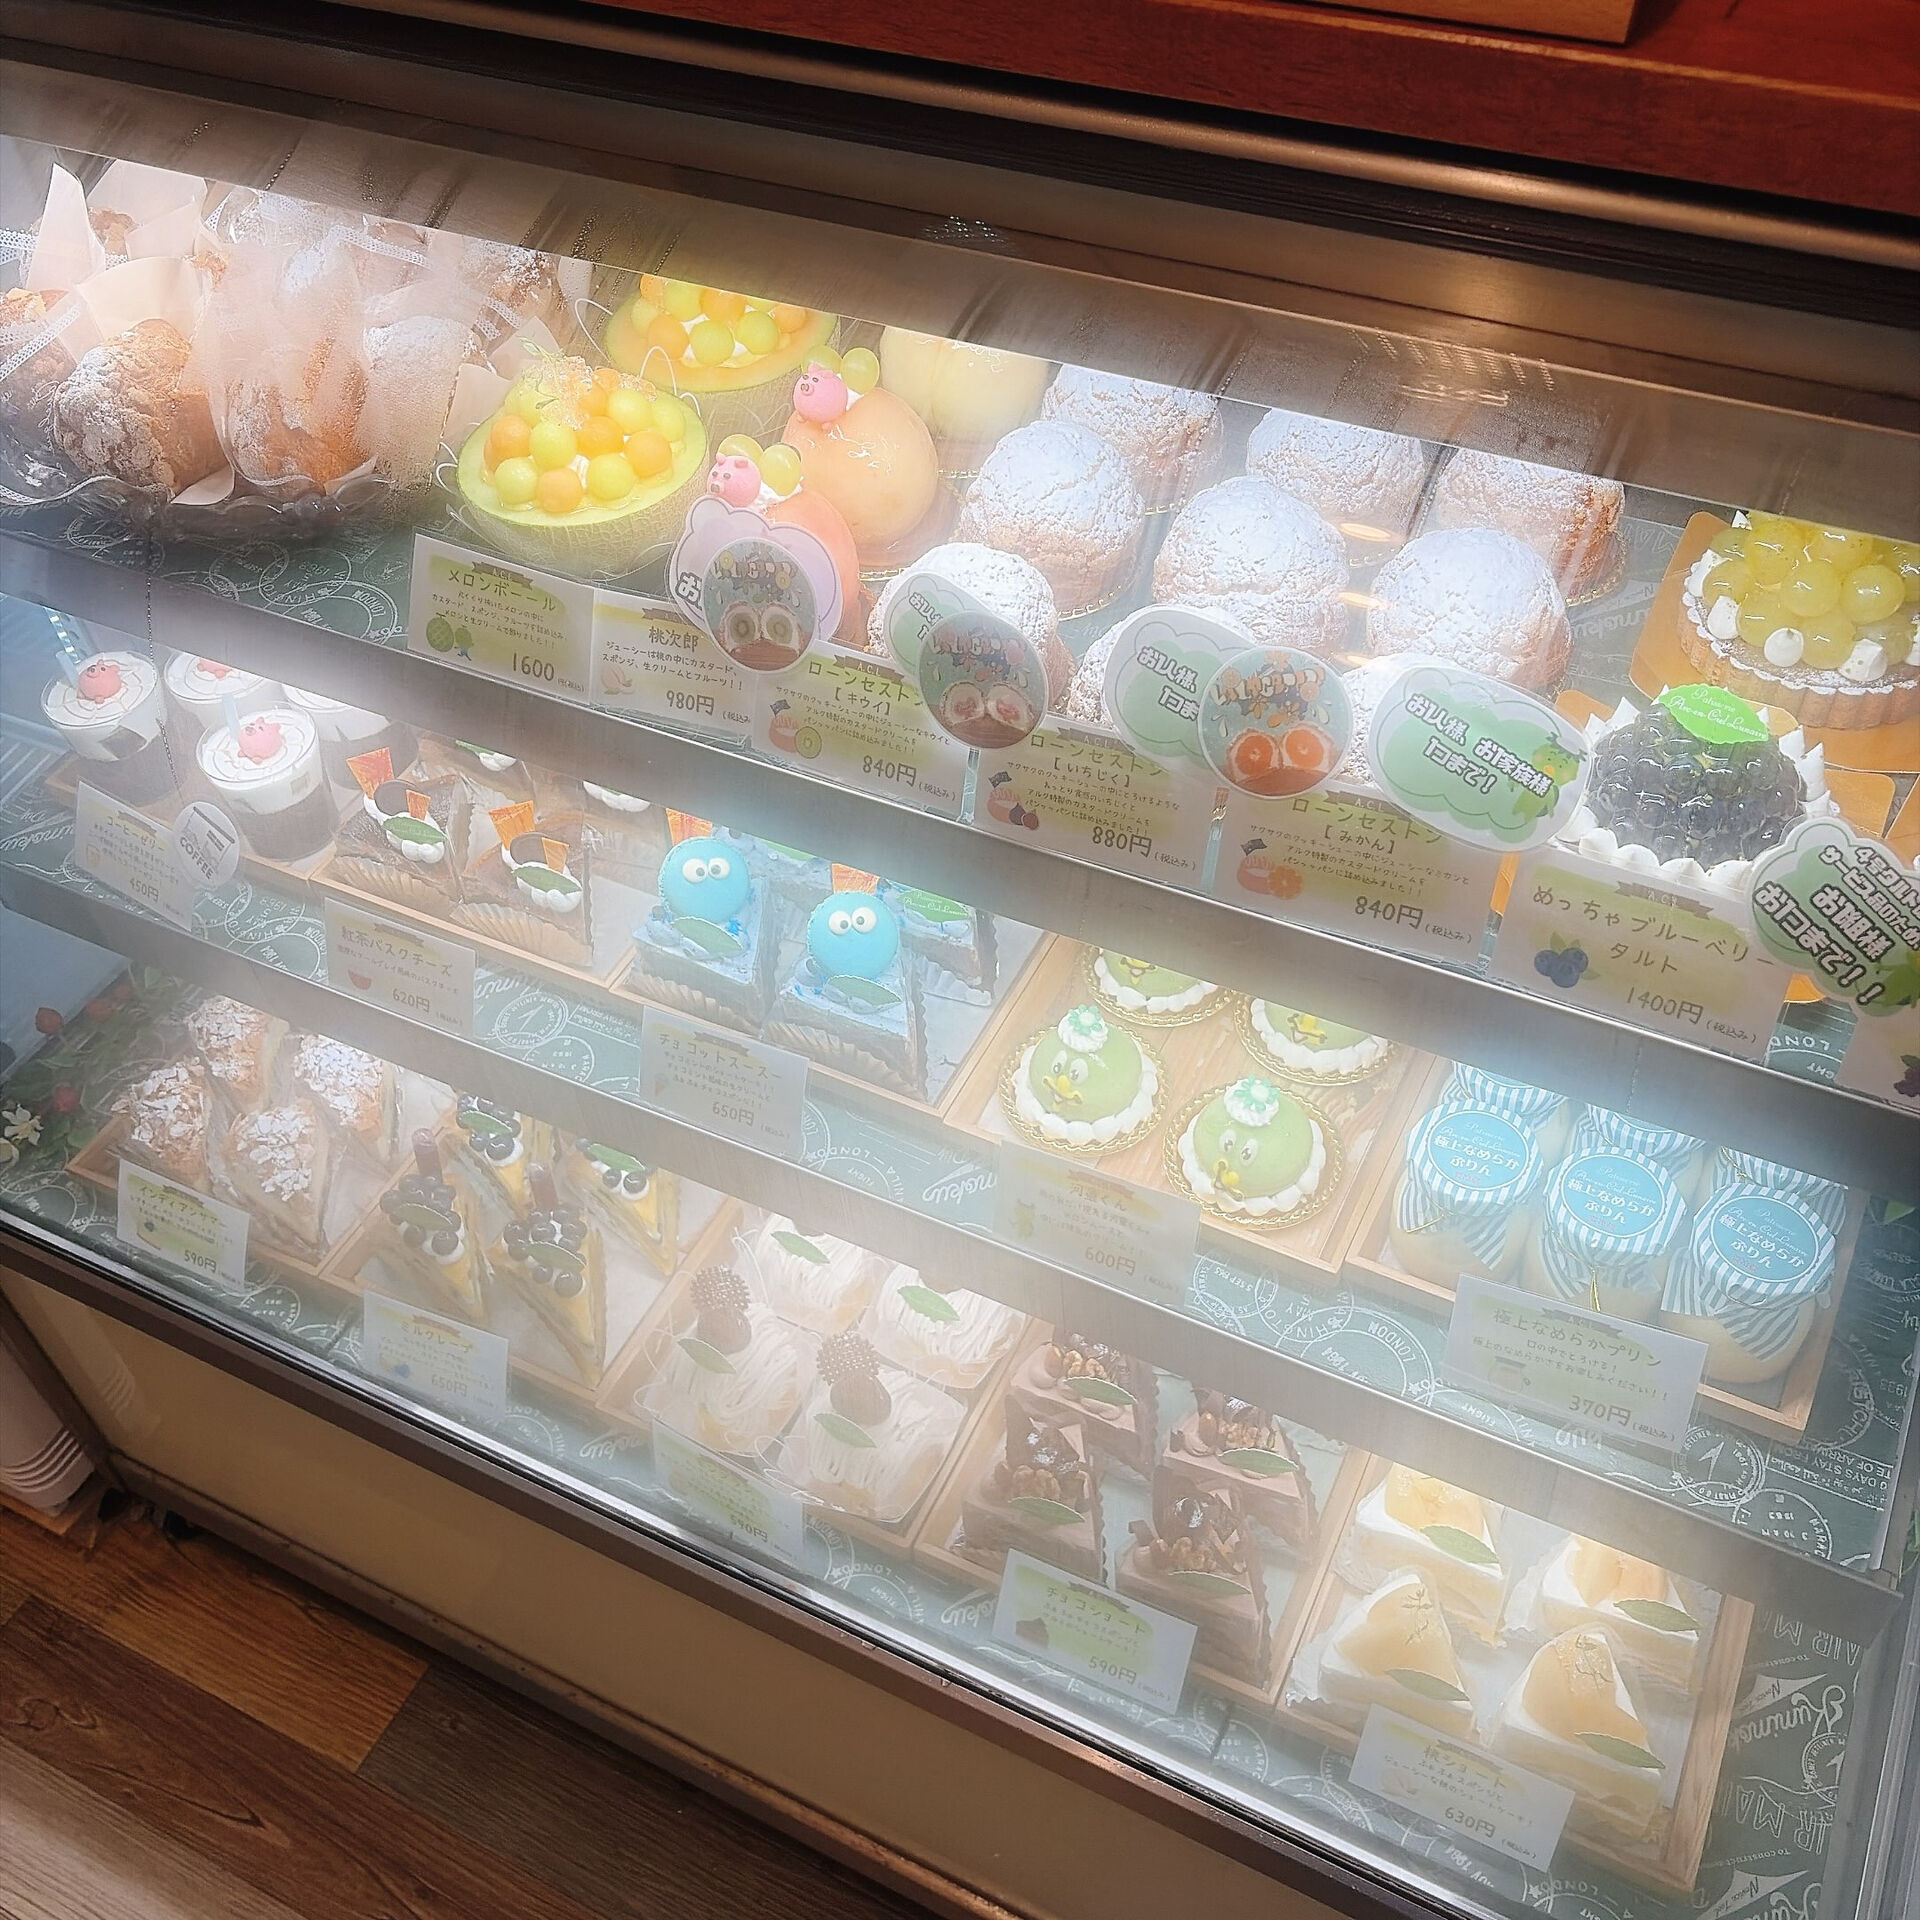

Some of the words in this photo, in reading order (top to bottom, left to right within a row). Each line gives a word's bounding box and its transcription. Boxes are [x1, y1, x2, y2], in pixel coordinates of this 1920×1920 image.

[448, 569, 556, 612] メロンボール
[648, 626, 699, 653] 桃次郎
[513, 651, 555, 681] 1600
[1137, 646, 1198, 693] お1人様、
[665, 689, 715, 716] 980円
[1157, 684, 1199, 721] 1コま
[1405, 693, 1471, 747] お1人様、
[863, 755, 917, 788] 840円
[1054, 757, 1131, 788] 【いちじく】
[1473, 737, 1556, 798] お1家族様
[1292, 798, 1442, 844] ローンセストン
[1092, 826, 1153, 858] 880円
[1154, 851, 1197, 871] (税込み)
[1323, 824, 1395, 855] 【みかん】
[179, 836, 214, 880] COFFEE
[130, 878, 160, 903] 450円
[1355, 896, 1423, 930] 840円
[1424, 923, 1472, 944] (税込み)
[1532, 885, 1777, 965] めっちゃブルーベリー
[1812, 883, 1895, 962] お1組様
[341, 926, 455, 977] 紅茶バスクチーズ
[1610, 942, 1679, 974] タルト
[392, 988, 430, 1013] 620円
[1627, 986, 1705, 1025] 1400円
[1706, 1019, 1757, 1044] (税込み)
[659, 1034, 783, 1080] チョコットスースー
[712, 1101, 755, 1128] 650円
[1434, 1135, 1520, 1171] 極上なめらか
[1450, 1155, 1492, 1177] ぷりん
[1568, 1178, 1656, 1217] 極上なめらか
[1584, 1199, 1625, 1224] ぷりん
[1720, 1213, 1805, 1268] 極上なめらか
[1730, 1238, 1776, 1269] ぷりん
[184, 1249, 217, 1274] 590円
[1084, 1247, 1137, 1277] 600円
[1492, 1307, 1662, 1367] 極上なめらかプリン
[431, 1374, 468, 1398] 650円
[1568, 1394, 1632, 1428] 370円
[1047, 1585, 1145, 1636] チョコショート
[1089, 1655, 1137, 1685] 590円
[1423, 1744, 1506, 1788] 桃ショート
[1445, 1806, 1497, 1838] 630円
